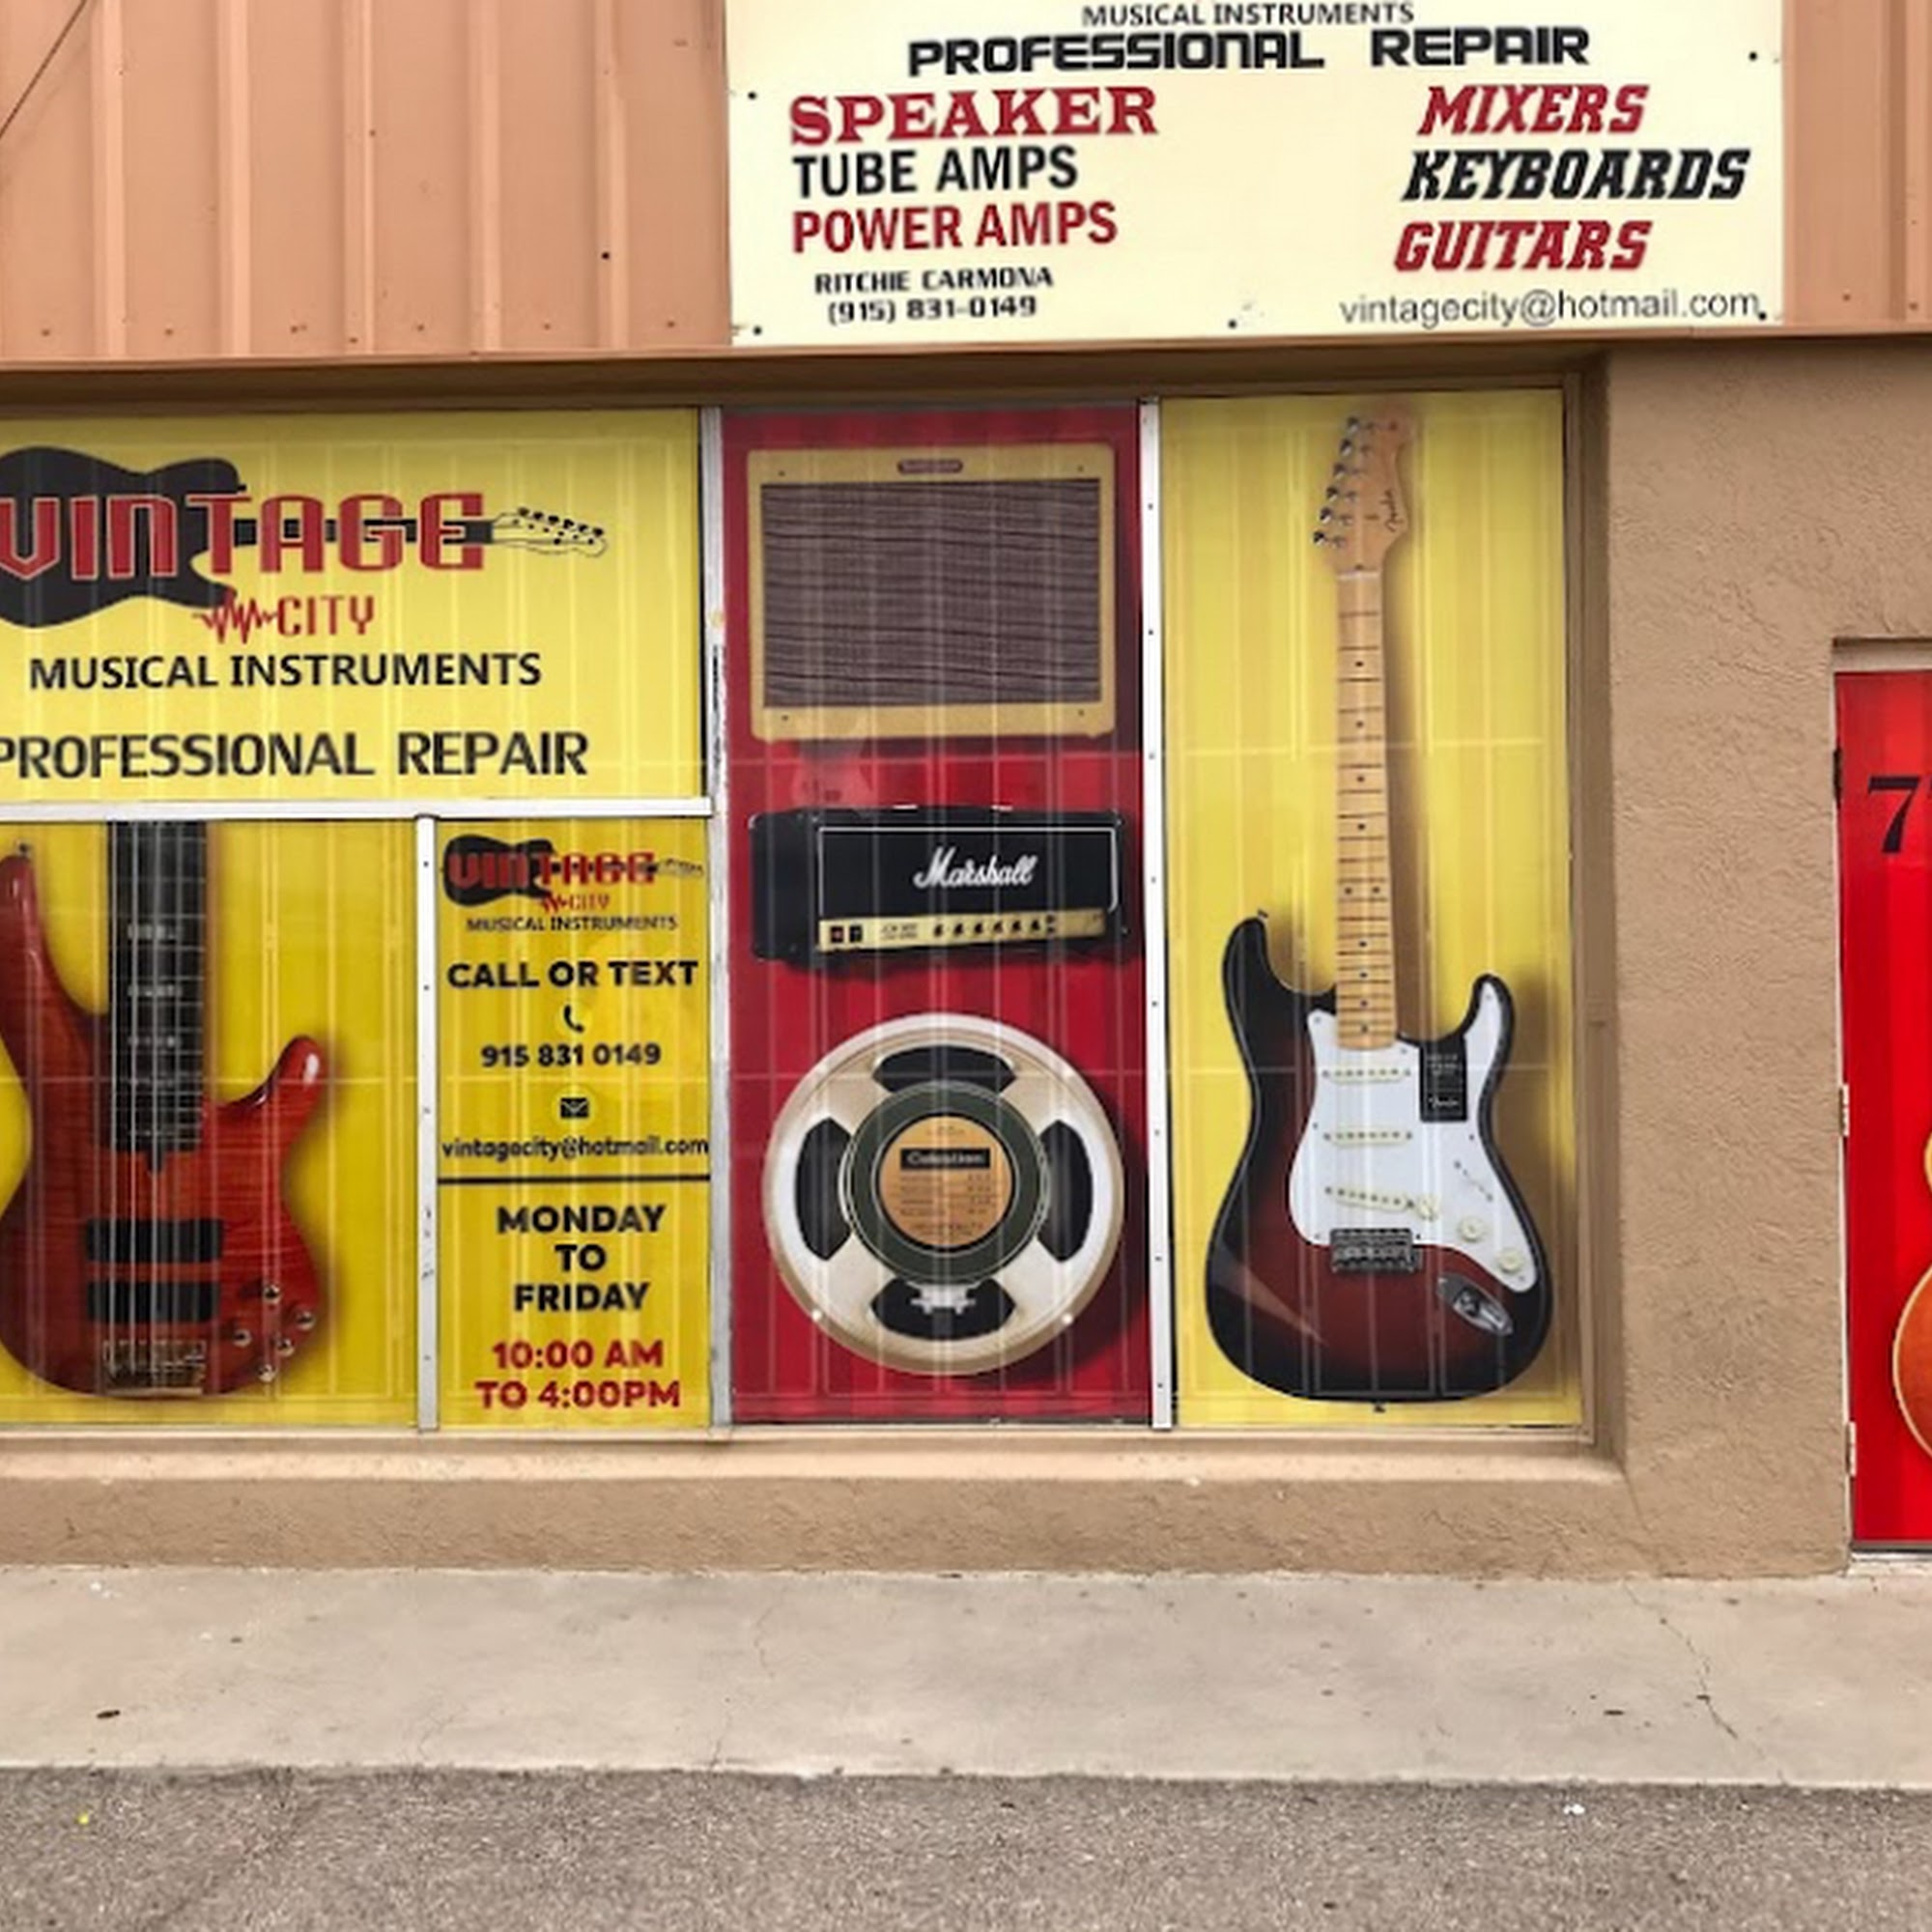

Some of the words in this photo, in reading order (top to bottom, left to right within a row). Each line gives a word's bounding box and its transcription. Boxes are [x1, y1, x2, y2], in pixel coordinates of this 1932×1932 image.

[1082, 5, 1207, 27] MUSICAL
[1212, 2, 1415, 26] INSTRUMENTS
[908, 30, 1325, 76] PROFESSIONAL
[1370, 26, 1591, 67] REPAIR
[789, 85, 1159, 146] SPEAKER
[1417, 83, 1650, 136] MIXERS
[792, 150, 918, 198] TUBE
[935, 145, 1079, 193] AMPS
[1401, 148, 1751, 202] KEYBOARDS
[792, 205, 963, 254] POWER
[976, 200, 1119, 248] AMPS
[1393, 219, 1653, 272] GUITARS
[814, 270, 911, 294] RITCHIE
[922, 266, 1055, 292] CARMONA
[828, 299, 896, 325] (915)
[906, 295, 1037, 321] 831-0149
[1339, 289, 1763, 329] vintagecity@hotmail.com
[0, 492, 486, 581] VINTAGE
[275, 595, 376, 637] CITY
[29, 655, 218, 691] MUSICAL
[229, 651, 542, 687] INSTRUMENTS
[397, 731, 589, 777] REPAIR
[1867, 775, 1932, 854] 7
[447, 851, 657, 891] VINTAGE
[912, 846, 1038, 889] Marshall
[467, 917, 546, 933] MUSICAL
[550, 914, 679, 932] INSTRUMENTS
[447, 963, 540, 989] CALL
[548, 960, 599, 987] OR
[607, 960, 699, 986] TEXT
[480, 1045, 531, 1068] 915
[537, 1043, 584, 1066] 831
[592, 1042, 662, 1065] 0149
[441, 1135, 710, 1163] vintagecity@hotmail.com
[496, 1205, 666, 1235] MONDAY
[554, 1243, 608, 1272] TO
[514, 1283, 650, 1313] FRIDAY
[492, 1340, 595, 1370] 10:00
[604, 1339, 664, 1368] AM
[474, 1380, 528, 1409] TO
[538, 1379, 681, 1408] 4:00PM
